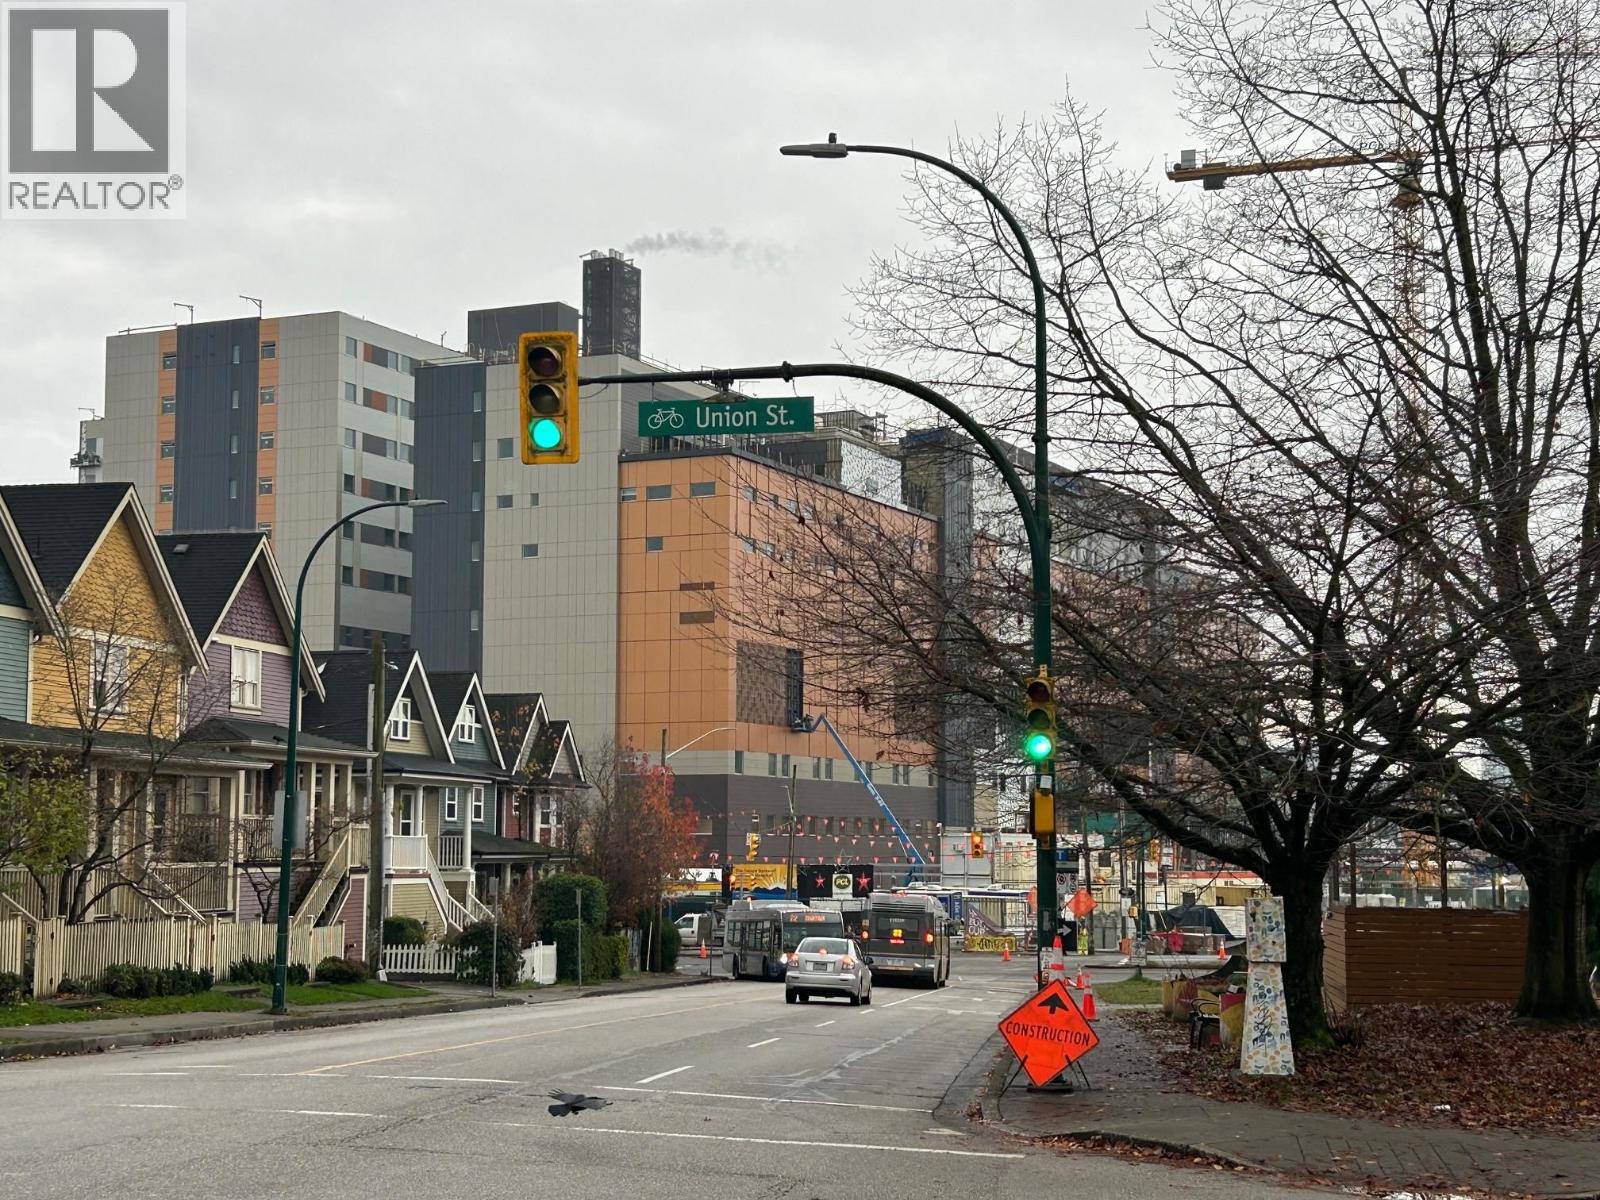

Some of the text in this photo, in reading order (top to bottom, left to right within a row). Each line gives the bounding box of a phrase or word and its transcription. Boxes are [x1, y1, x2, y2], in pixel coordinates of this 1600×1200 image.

[696, 403, 795, 428] Union St.
[1006, 1021, 1090, 1047] CONSTRUCTION
